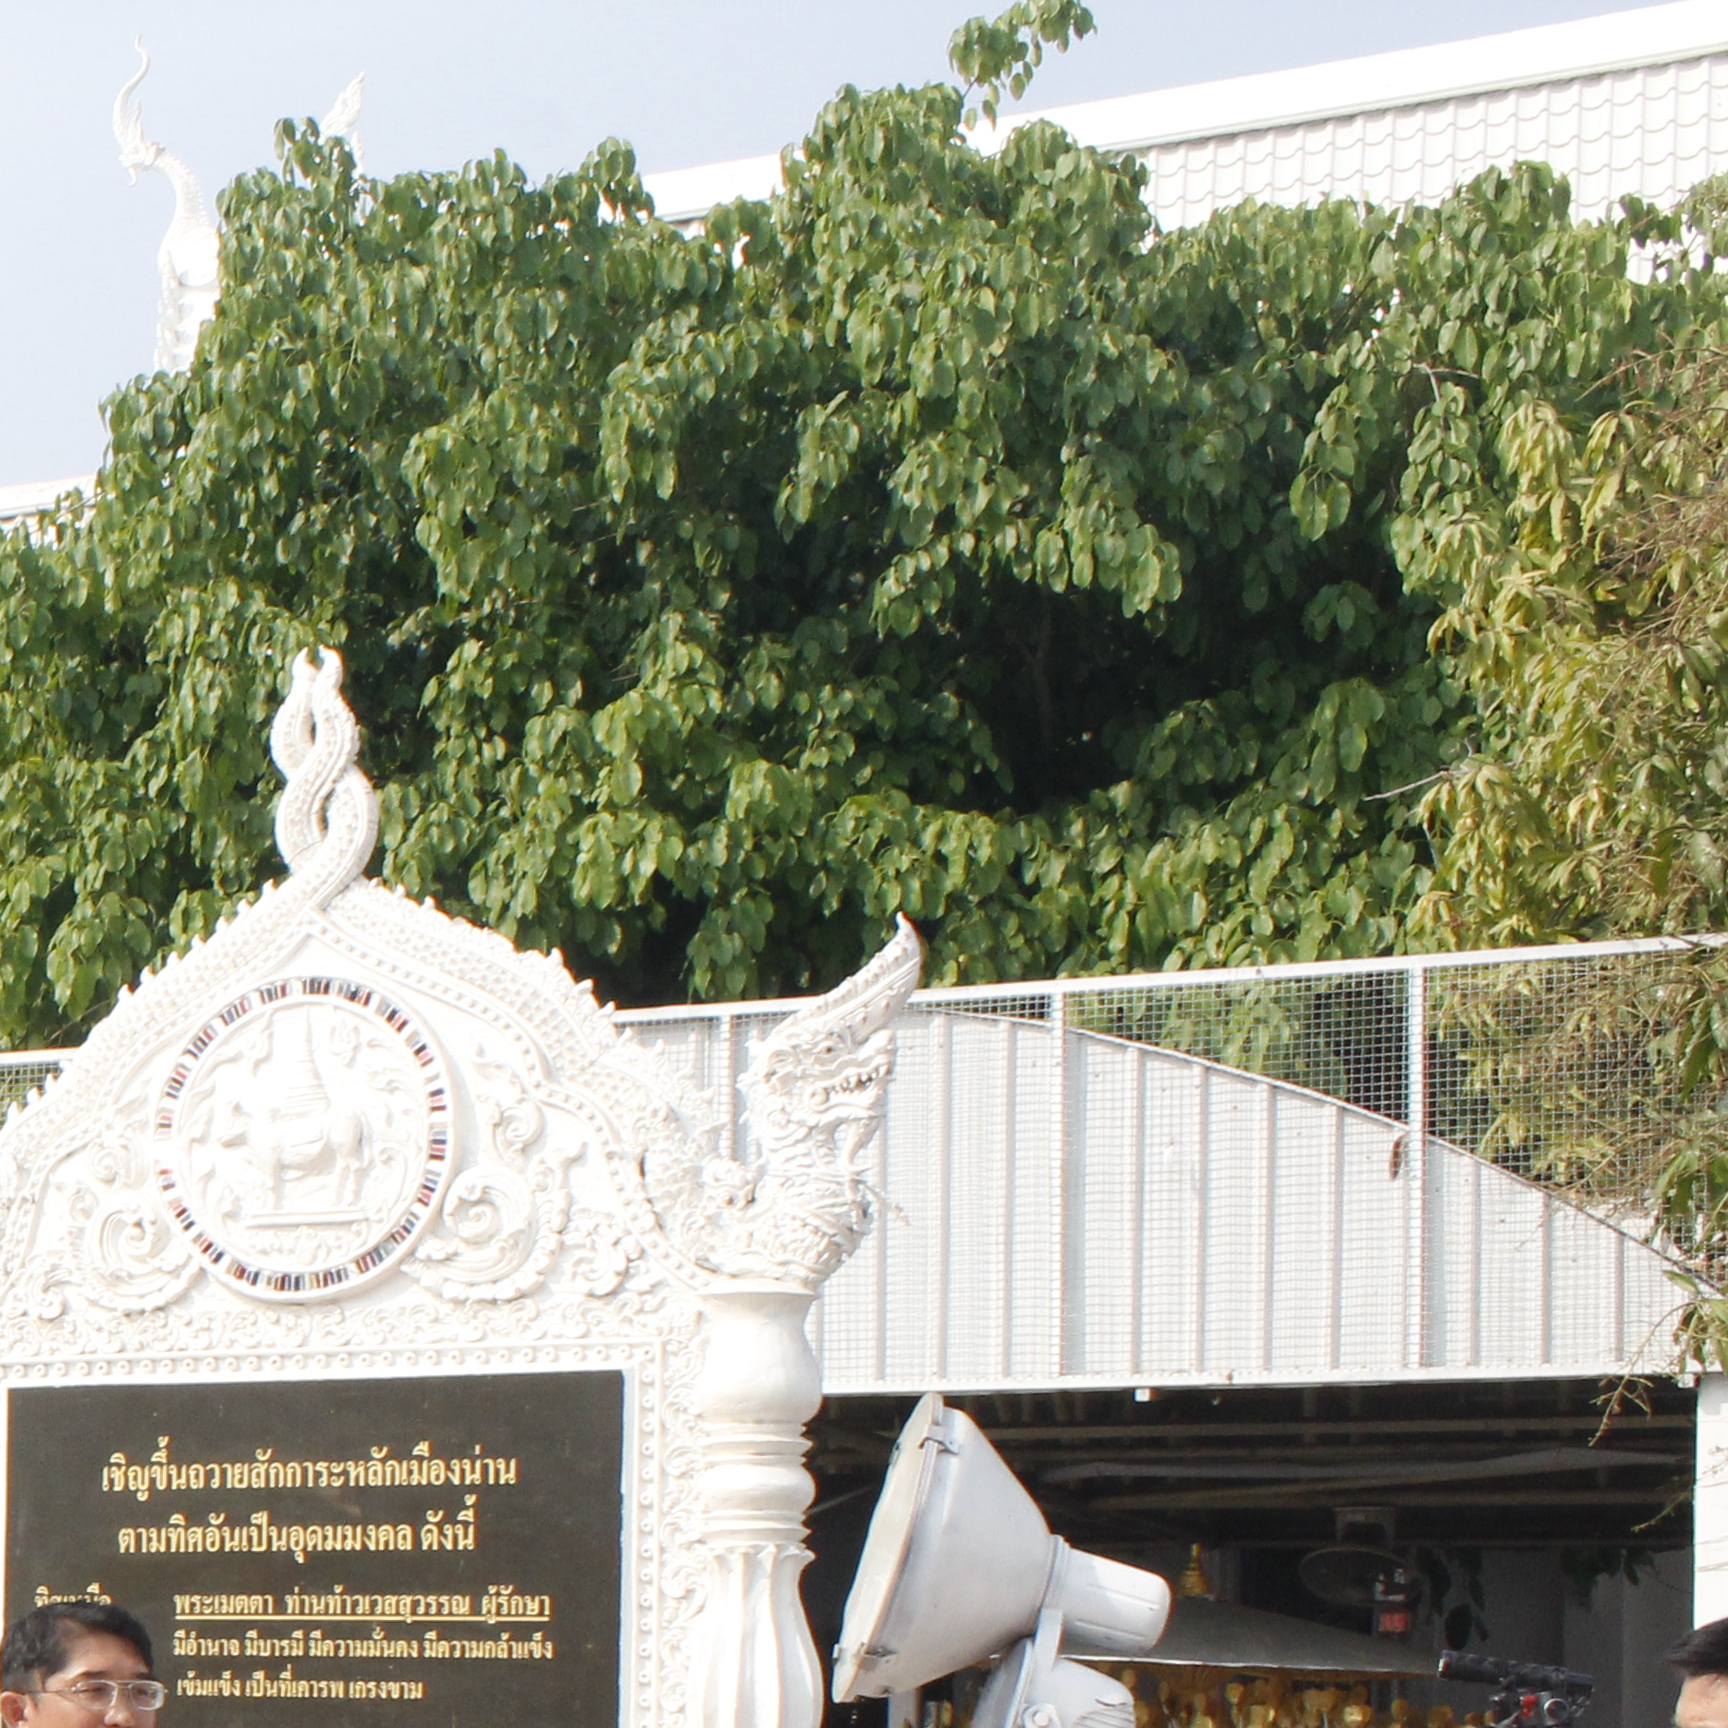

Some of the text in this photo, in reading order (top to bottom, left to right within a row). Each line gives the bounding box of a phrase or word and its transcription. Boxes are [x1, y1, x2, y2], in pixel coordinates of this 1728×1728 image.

[101, 1435, 519, 1501] เชิญขึ้นถวายสักการะหลักเมืองน่าน
[118, 1493, 479, 1564] ตามทิศอันเป็นอุดมมงคล ดังนี้
[172, 1592, 275, 1615] พระเมตตา
[284, 1583, 472, 1623] ท่านท้าวเวสสุวรรณ
[480, 1584, 552, 1624] ผู้รักษา
[172, 1625, 555, 1660] มีอำนาจ มีบารมี มีความมั่นคง มีความกล้าแข็ง
[176, 1663, 426, 1701] เข้มแข็ง เป็นที่เคารพ เกรงขาม
